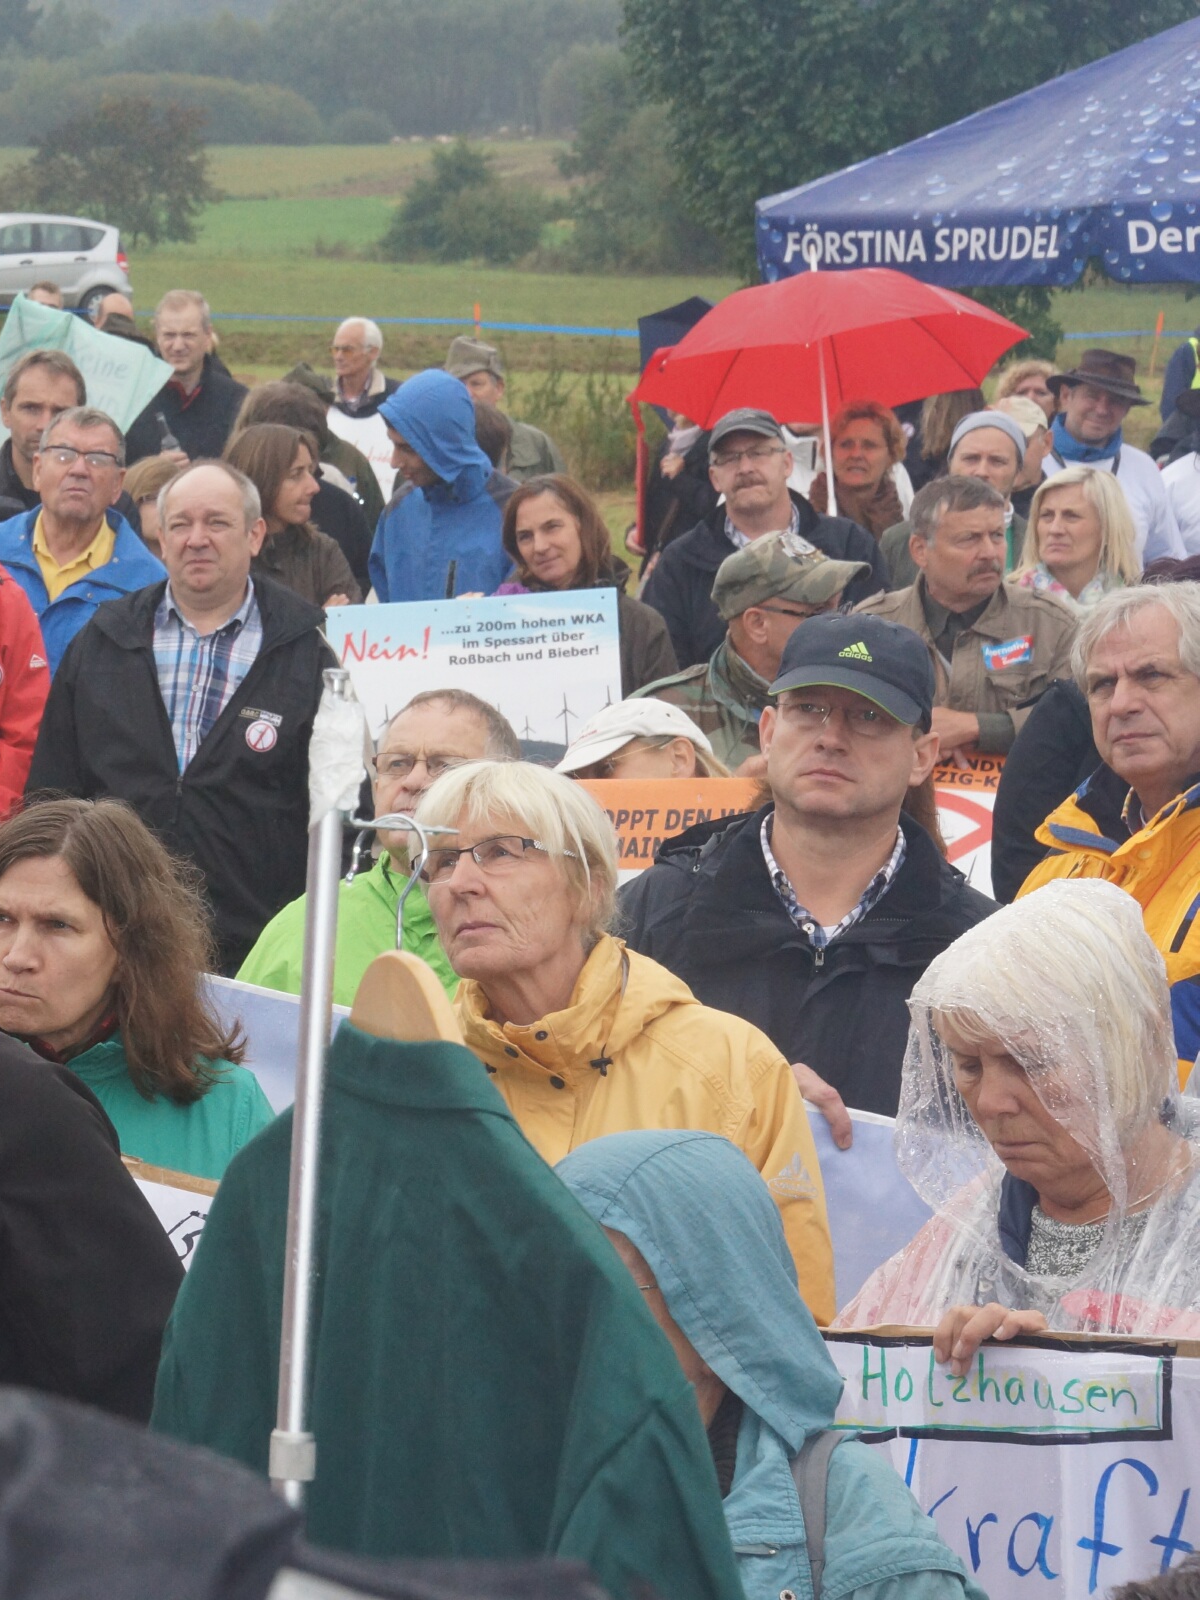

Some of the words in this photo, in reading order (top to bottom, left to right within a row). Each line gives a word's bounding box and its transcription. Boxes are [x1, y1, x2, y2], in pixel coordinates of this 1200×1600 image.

[783, 223, 927, 264] FÖRSTINA
[934, 225, 1060, 262] SPRUDEL
[1127, 220, 1200, 254] Der
[477, 621, 516, 633] 200m
[521, 617, 566, 630] hohen
[570, 612, 605, 625] WKA
[341, 625, 431, 664] Nein!
[462, 638, 479, 649] im
[484, 633, 547, 649] Spessart
[551, 631, 585, 643] über
[449, 651, 511, 666] Roßbach
[516, 649, 543, 662] und
[548, 645, 600, 659] Bieber!
[838, 651, 873, 663] adidas
[861, 1345, 1138, 1415] Holzhausen
